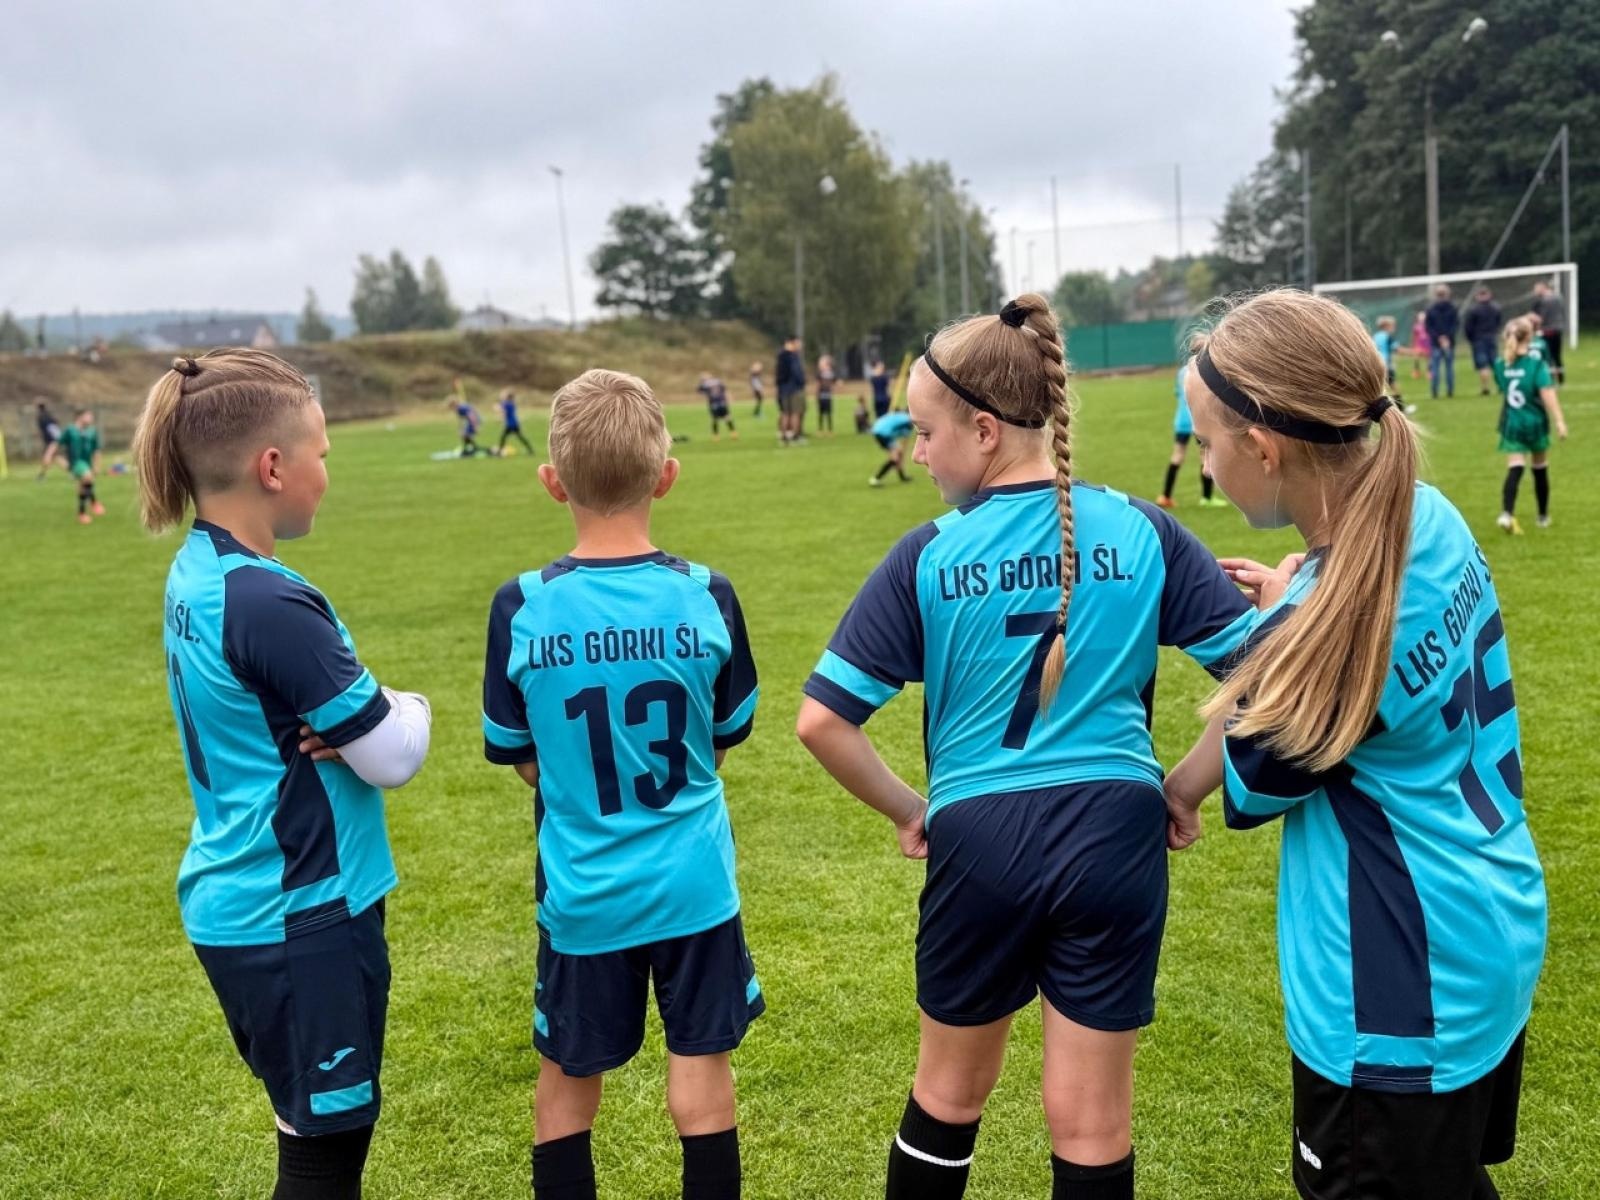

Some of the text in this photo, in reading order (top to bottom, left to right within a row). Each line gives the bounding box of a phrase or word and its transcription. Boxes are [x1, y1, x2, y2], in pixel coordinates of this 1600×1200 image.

[1507, 378, 1526, 410] 6
[938, 562, 989, 602] LKS
[1092, 543, 1134, 582] ŚL.
[174, 599, 201, 644] ŚL.
[528, 622, 711, 670] LKS GÓRKI ŚL.
[1393, 629, 1448, 698] LKS
[1442, 560, 1484, 648] GÓRKI
[1000, 610, 1066, 751] 7
[564, 679, 690, 817] 13
